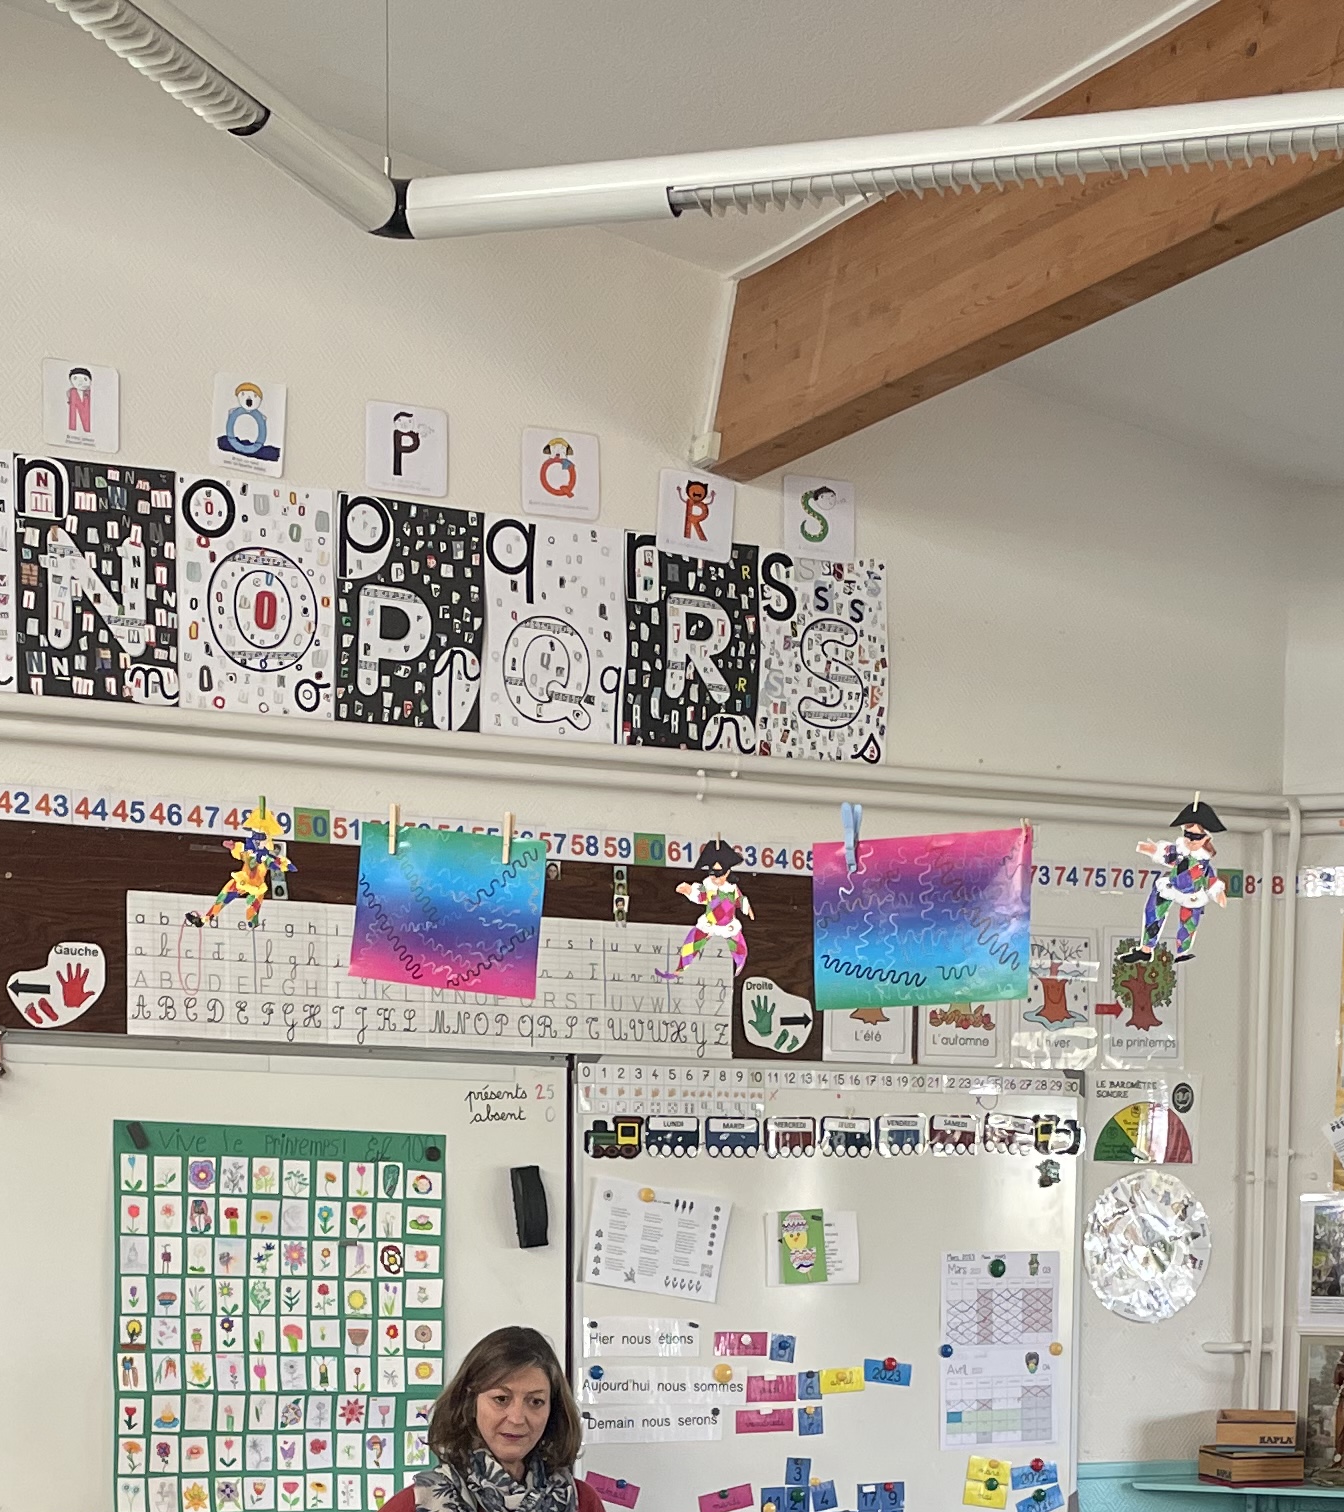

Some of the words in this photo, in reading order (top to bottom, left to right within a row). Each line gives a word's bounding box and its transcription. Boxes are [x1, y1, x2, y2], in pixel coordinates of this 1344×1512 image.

[67, 388, 92, 433] N
[225, 407, 268, 453] O
[392, 429, 419, 476] P
[539, 457, 577, 498] Q
[684, 502, 707, 542] R
[801, 489, 829, 543] S
[35, 793, 69, 818] 43
[74, 797, 109, 822] 44
[112, 799, 146, 824] 45
[149, 803, 183, 827] 46
[187, 805, 220, 830] 47
[571, 833, 599, 858] 58
[604, 837, 632, 860] 59
[667, 841, 693, 864] 61
[54, 943, 99, 958] Gauche
[745, 981, 773, 991] Droite
[854, 1030, 882, 1042] L'été
[932, 1034, 990, 1046] L'automne
[1111, 1037, 1123, 1047] Le
[465, 1084, 528, 1112] présents
[534, 1084, 555, 1100] 25
[469, 1107, 526, 1125] absent
[589, 1333, 614, 1345] Hier
[621, 1335, 651, 1345] nous
[658, 1332, 693, 1345] étions
[582, 1379, 650, 1395] Aujourd'hui
[657, 1382, 687, 1392] nous
[693, 1380, 744, 1392] sommes
[587, 1416, 634, 1430] Demain
[641, 1416, 671, 1428] nous
[677, 1413, 718, 1427] serons
[1259, 1436, 1293, 1444] KAPLA
[793, 1467, 802, 1481] 3
